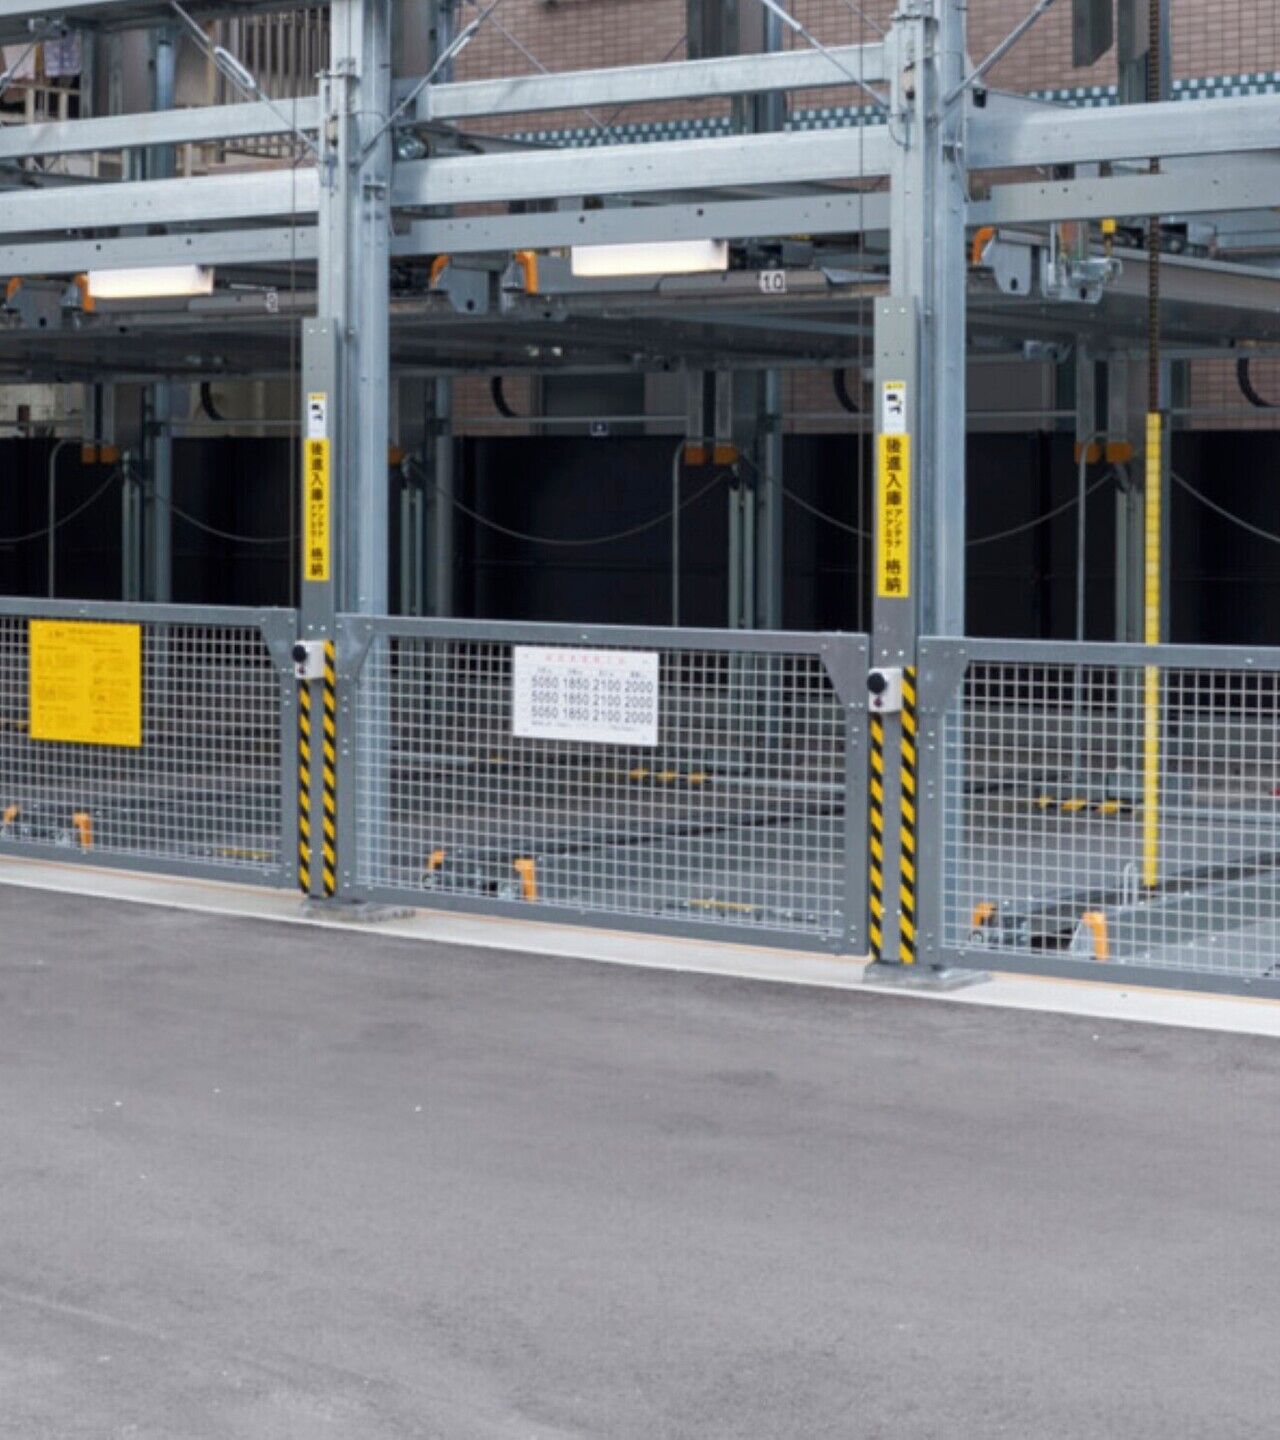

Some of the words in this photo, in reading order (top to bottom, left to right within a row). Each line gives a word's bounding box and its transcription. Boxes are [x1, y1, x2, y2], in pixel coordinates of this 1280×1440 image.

[763, 272, 784, 290] 10
[885, 437, 902, 506] 後進入庫
